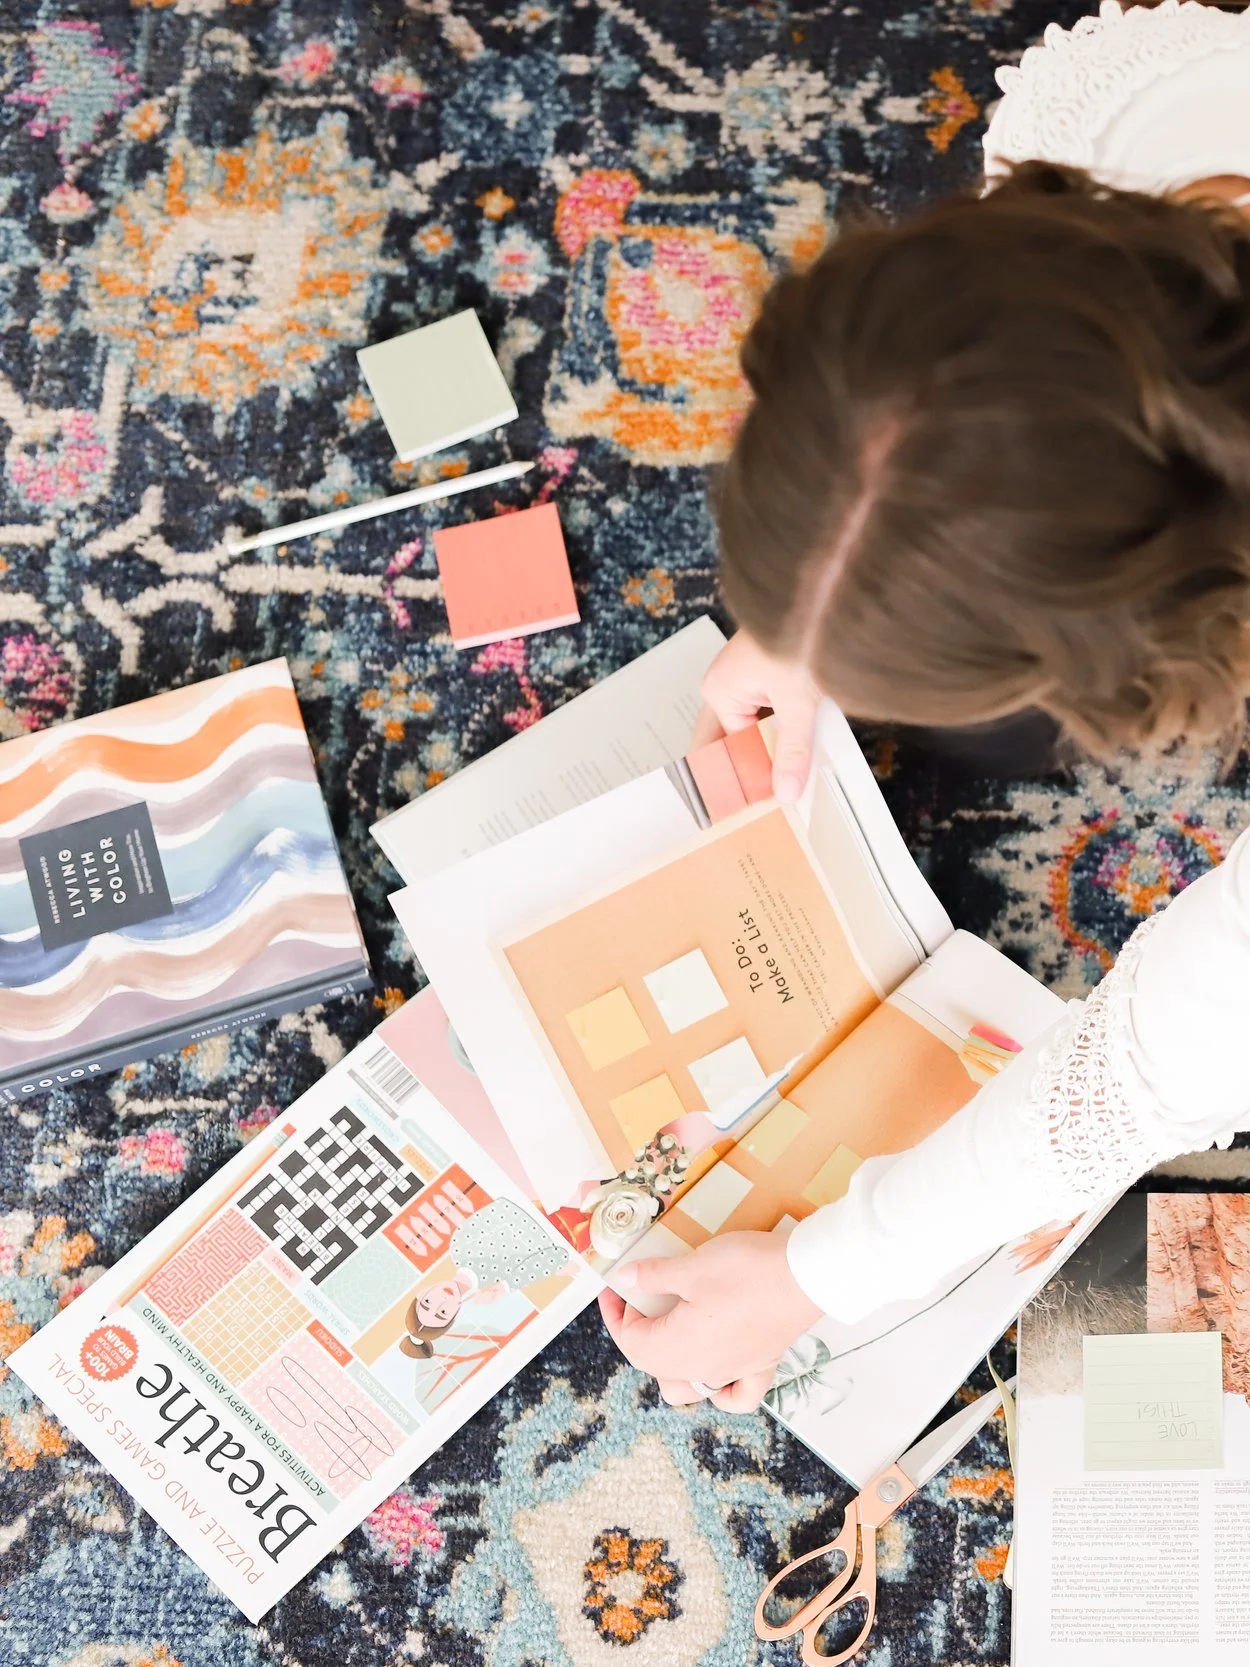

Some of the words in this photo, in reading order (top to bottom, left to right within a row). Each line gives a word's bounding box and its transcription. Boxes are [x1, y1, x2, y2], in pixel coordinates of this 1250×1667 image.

[39, 855, 51, 887] ATWOOD
[58, 849, 85, 918] LIVING
[80, 851, 103, 903] WITH
[99, 836, 126, 903] COLOR
[47, 889, 60, 924] REBECCA
[738, 908, 760, 940] List
[731, 938, 752, 969] Do:
[757, 943, 768, 953] a
[749, 971, 763, 992] To
[765, 958, 793, 1003] Make
[20, 1063, 101, 1092] COLOR
[142, 1308, 168, 1333] MIND
[92, 1343, 101, 1353] TO
[97, 1336, 112, 1351] YOUR
[104, 1329, 134, 1360] BRAIN
[109, 1350, 127, 1366] BUILD
[166, 1334, 207, 1374] HEALTHY
[315, 1327, 345, 1358] SUDOKU
[85, 1352, 111, 1377] 100+
[99, 1351, 118, 1370] GAMES
[48, 1352, 112, 1422] SPECIAL
[205, 1373, 226, 1393] AND
[224, 1394, 255, 1424] HAPPY
[1135, 1400, 1188, 1419] THIS!
[254, 1422, 261, 1431] A
[260, 1429, 280, 1451] FOR
[1156, 1420, 1199, 1439] LOVE
[106, 1419, 165, 1480] GAMES
[135, 1363, 317, 1563] Breathe
[278, 1449, 325, 1496] ACTIVITIES
[164, 1480, 206, 1518] AND
[199, 1517, 264, 1584] PUZZLE
